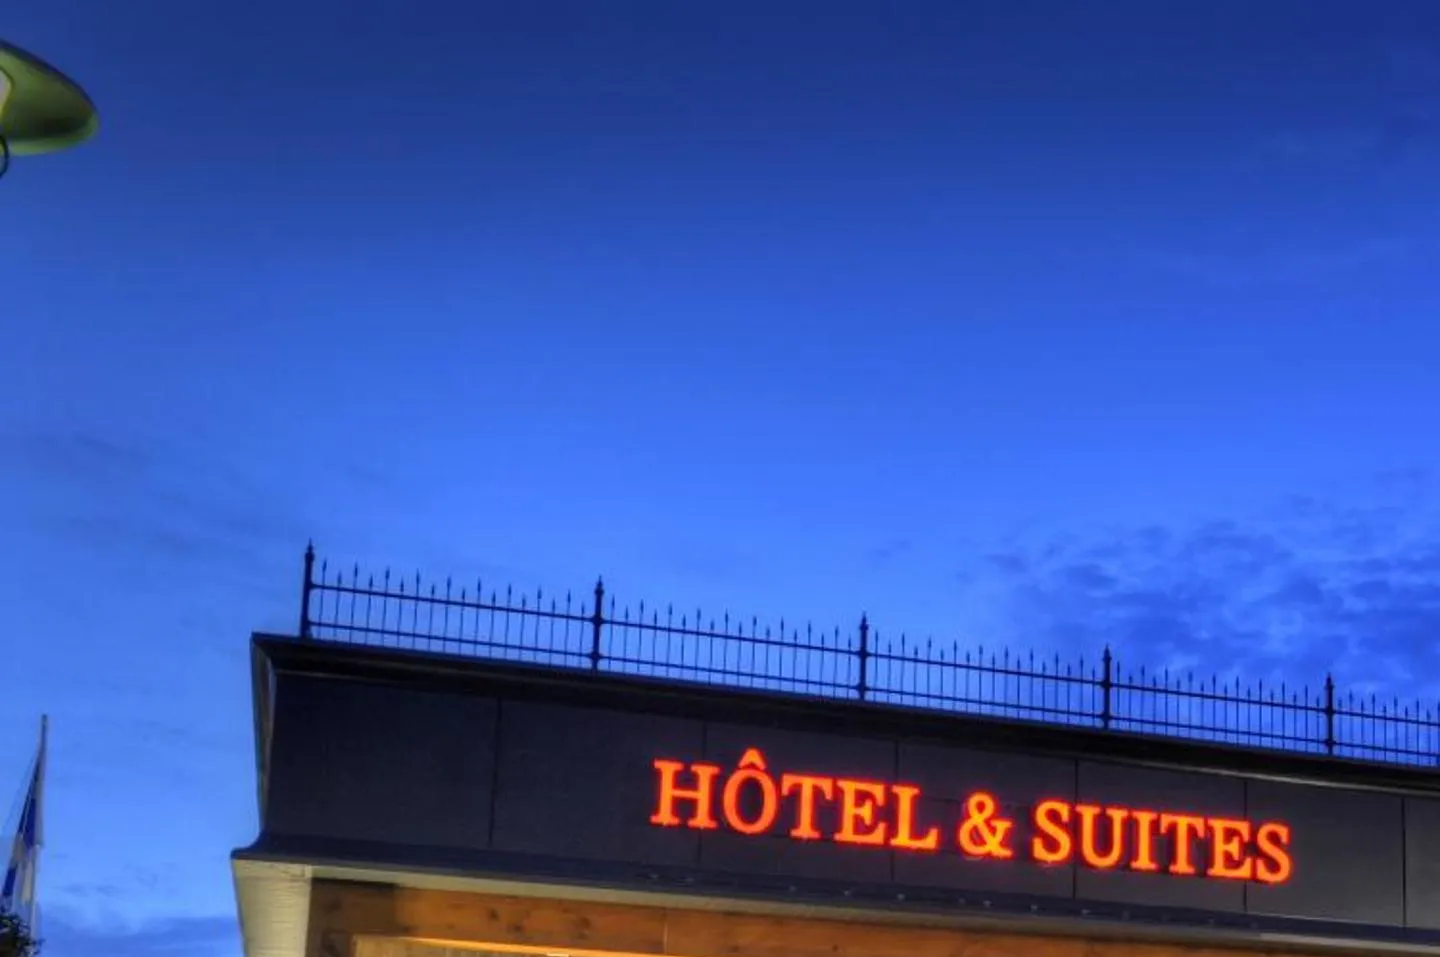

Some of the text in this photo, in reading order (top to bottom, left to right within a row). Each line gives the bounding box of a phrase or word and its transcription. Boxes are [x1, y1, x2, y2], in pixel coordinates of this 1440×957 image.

[650, 747, 1293, 884] HÔTEL & SUITES
